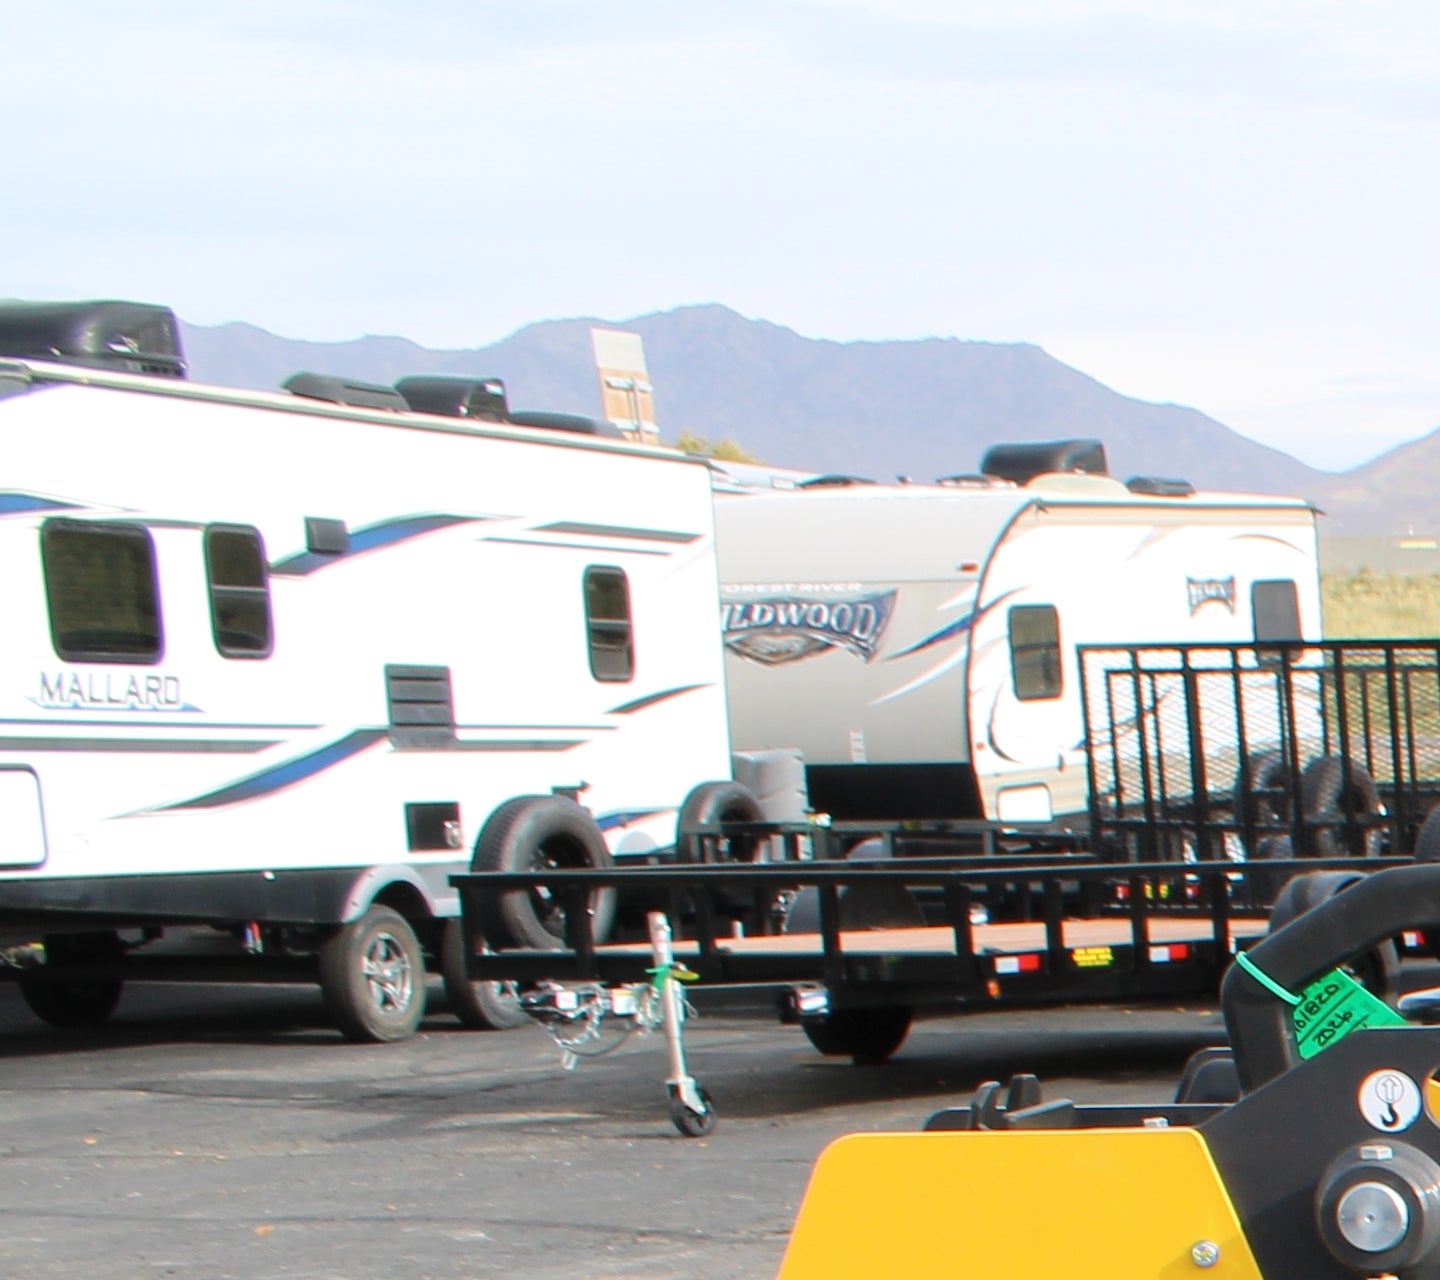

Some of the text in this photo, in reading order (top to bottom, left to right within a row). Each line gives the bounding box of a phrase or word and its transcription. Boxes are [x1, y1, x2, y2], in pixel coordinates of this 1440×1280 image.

[720, 583, 796, 593] OREST
[721, 602, 878, 641] ILDWOOD
[40, 671, 180, 705] MALLARD
[1295, 984, 1339, 1033] 01820
[1312, 1010, 1353, 1047] 2026
